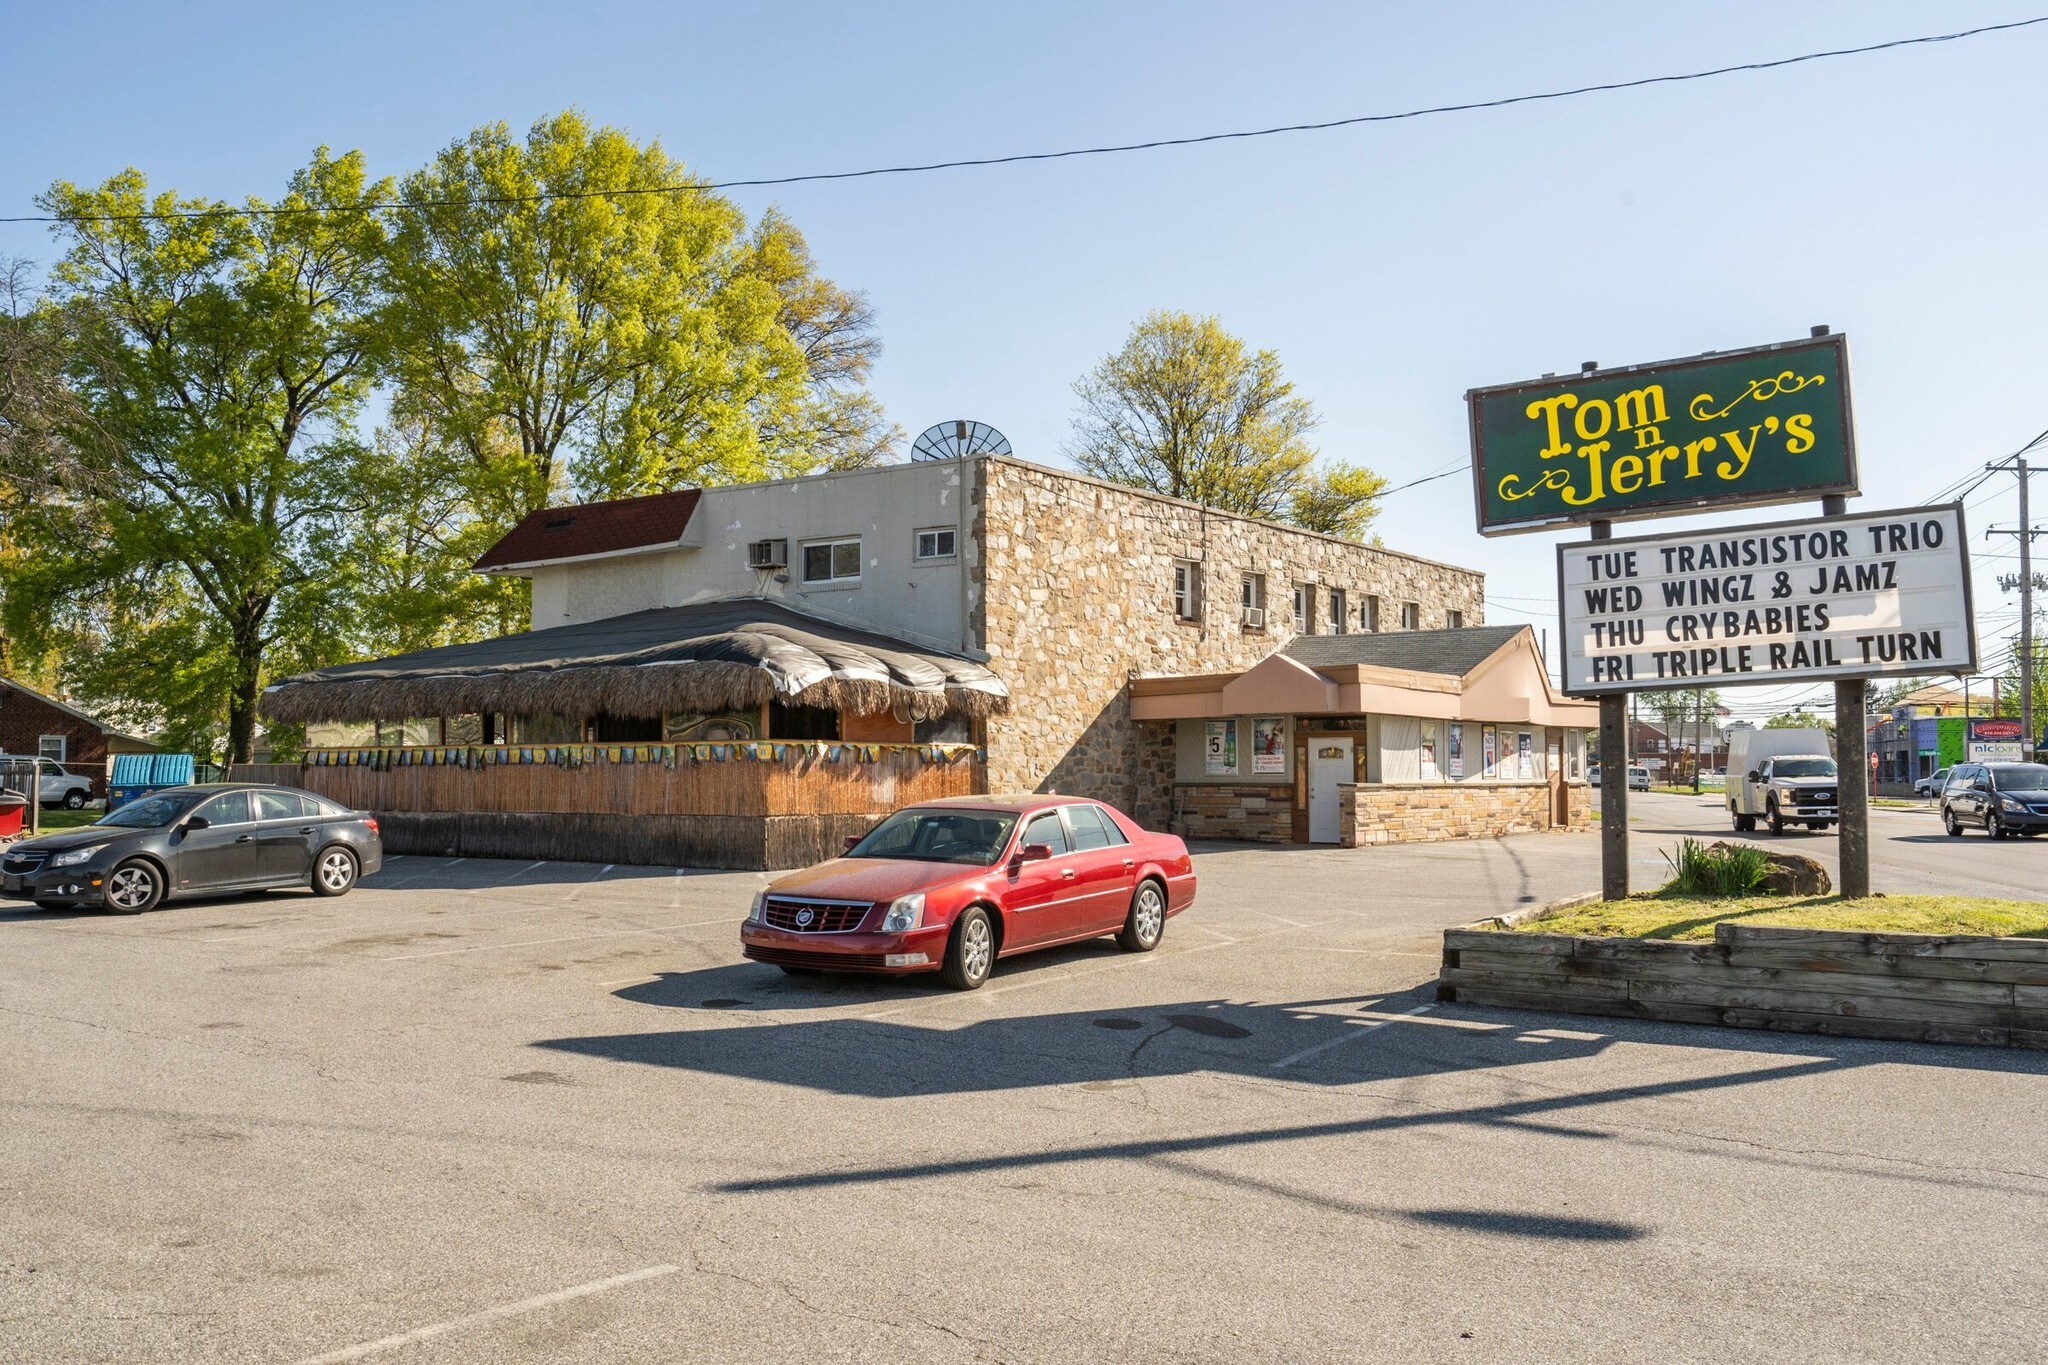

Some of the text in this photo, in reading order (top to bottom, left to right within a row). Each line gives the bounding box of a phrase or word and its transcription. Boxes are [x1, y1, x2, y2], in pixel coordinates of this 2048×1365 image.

[1526, 384, 1670, 459] Tom
[1635, 426, 1665, 450] n
[1561, 413, 1815, 505] Jerry's
[1586, 519, 1944, 581] TUE TRANSISTOR TRIO
[1584, 560, 1897, 615] WED WINGZ & JAMZ
[1590, 603, 1830, 648] THU CRYBABIES
[1592, 630, 1943, 683] FRI TRIPLE RAIL TURN
[1208, 736, 1220, 753] $5
